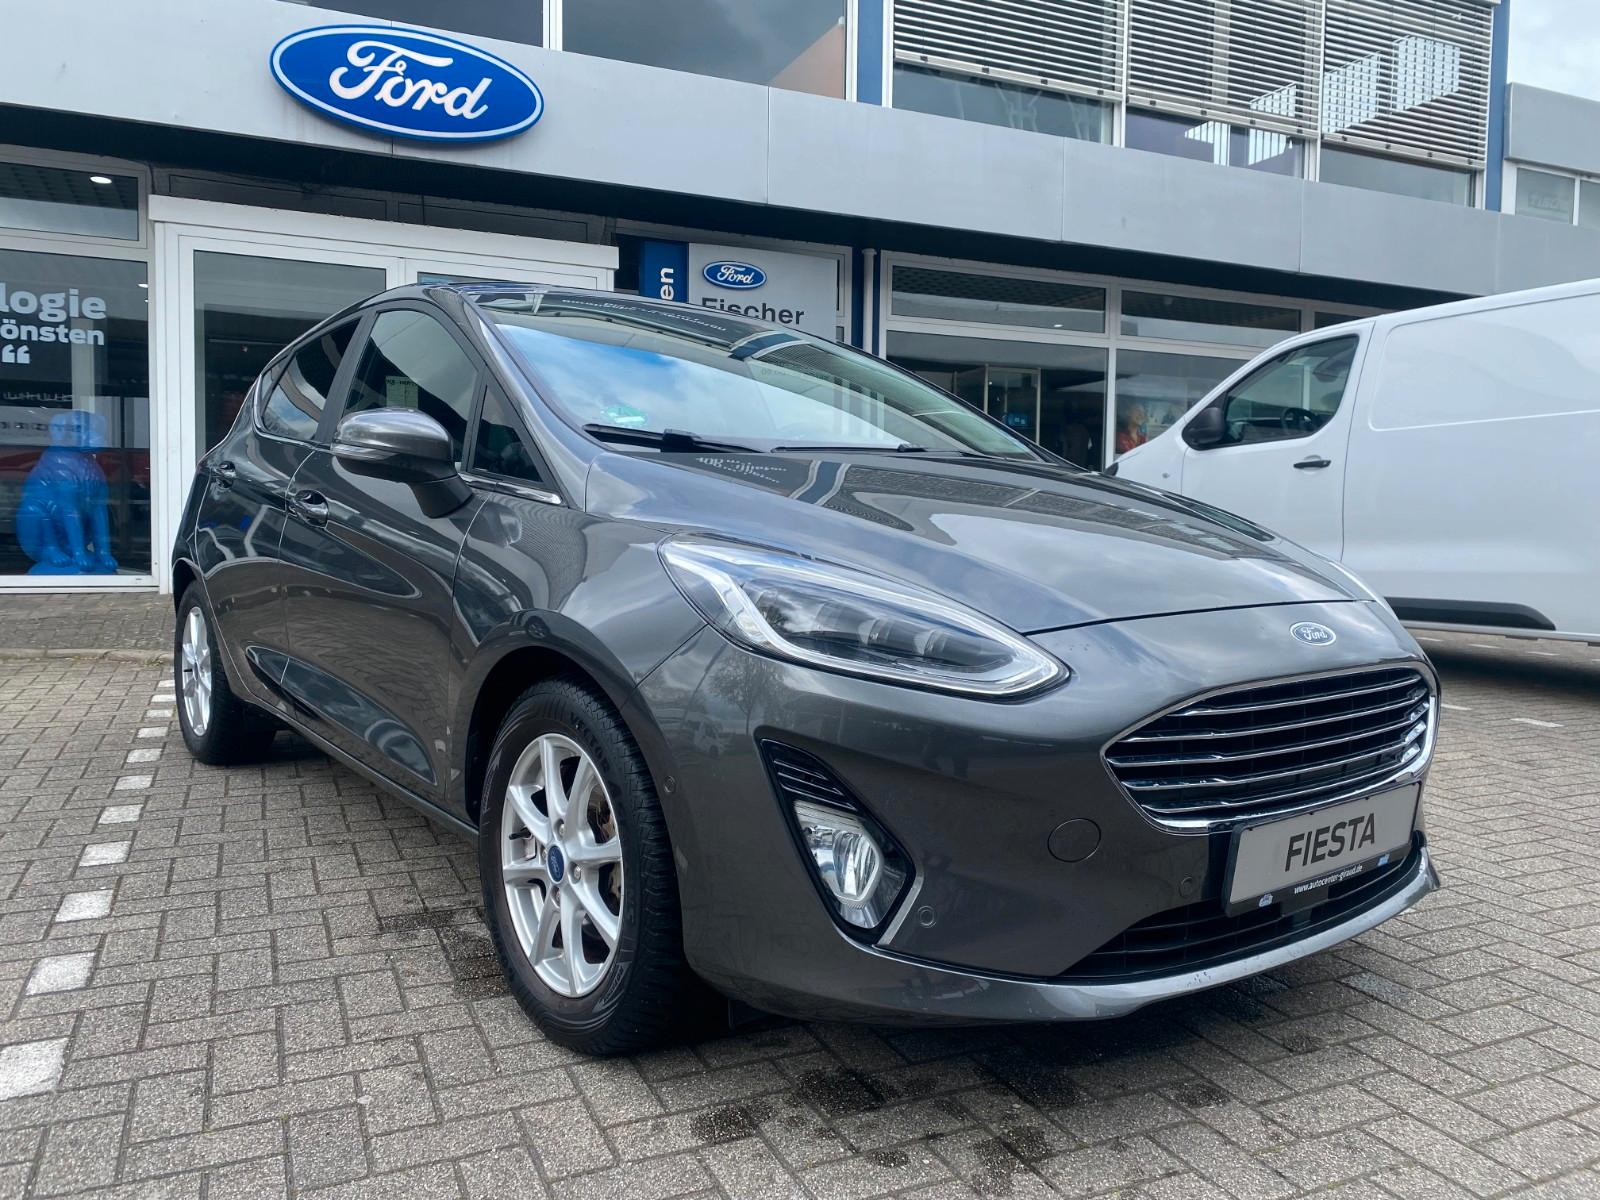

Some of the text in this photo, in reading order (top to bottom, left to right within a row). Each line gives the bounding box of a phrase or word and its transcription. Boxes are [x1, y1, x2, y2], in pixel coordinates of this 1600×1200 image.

[329, 40, 493, 120] Ford
[660, 267, 675, 301] en
[716, 264, 755, 284] Ford
[0, 318, 105, 346] önsten
[1300, 626, 1329, 641] Ford
[1284, 812, 1376, 873] FIESTA
